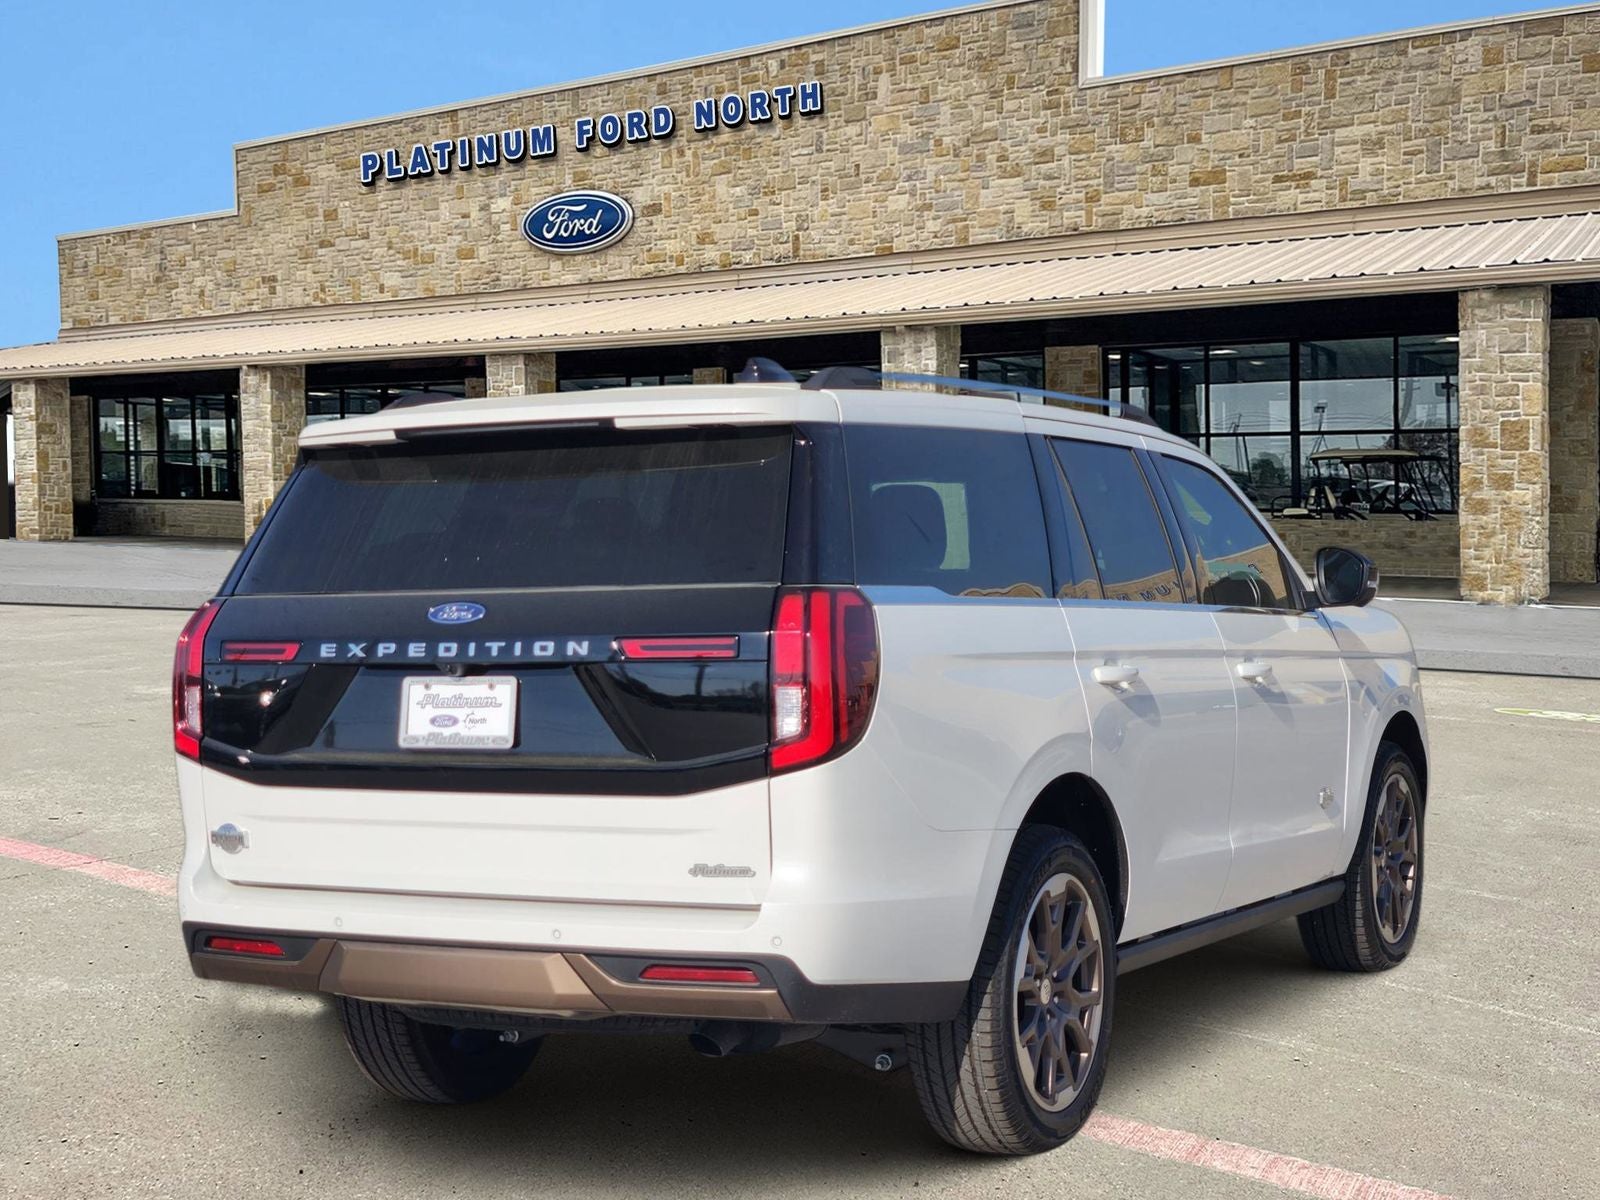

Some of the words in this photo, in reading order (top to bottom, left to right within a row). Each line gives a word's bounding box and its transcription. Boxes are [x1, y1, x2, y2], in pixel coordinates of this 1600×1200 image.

[360, 124, 557, 187] PLATINUM
[575, 105, 676, 152] FORD
[694, 81, 823, 133] NORTH
[543, 204, 602, 239] Ford
[320, 641, 589, 657] EXPEDITION
[416, 693, 502, 708] Platinum
[688, 863, 756, 877] Platinum
